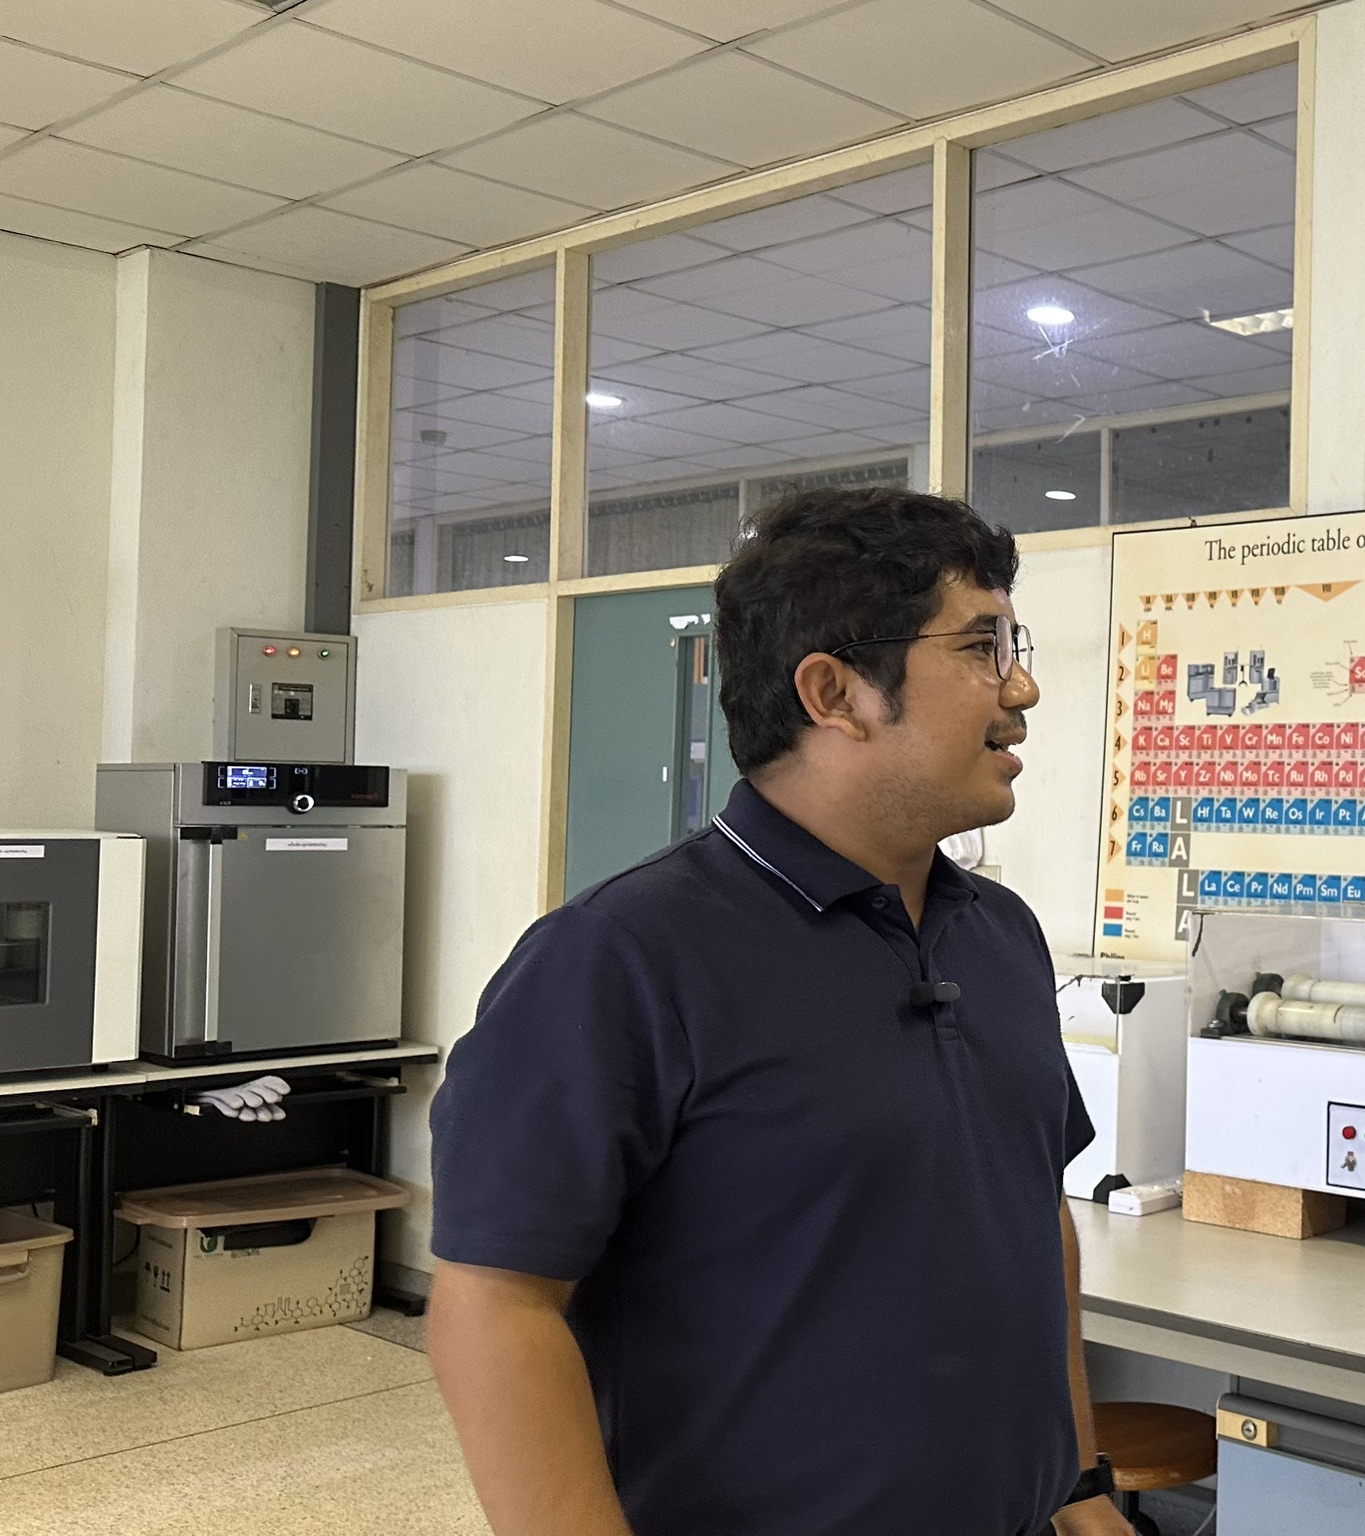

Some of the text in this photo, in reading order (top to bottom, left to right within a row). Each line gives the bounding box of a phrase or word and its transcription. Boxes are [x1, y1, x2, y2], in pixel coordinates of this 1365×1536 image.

[1204, 538, 1236, 561] The
[1241, 532, 1306, 566] periodic
[1311, 527, 1351, 553] table
[1118, 665, 1125, 682] 2
[1160, 663, 1173, 675] Be
[1116, 699, 1174, 717] 3 Na Mg
[1114, 735, 1121, 751] 4
[1156, 734, 1170, 746] Ca
[1179, 734, 1190, 746] Sc
[1201, 733, 1212, 745] Ti
[1244, 733, 1259, 745] Cr
[1266, 733, 1283, 745] Mn
[1292, 732, 1305, 745] Fe
[1314, 732, 1330, 745] Co
[1340, 732, 1353, 744] Ni
[1113, 769, 1120, 787] 5
[1134, 770, 1147, 782] Rb
[1156, 769, 1168, 782] Sr
[1198, 769, 1211, 782] Zr
[1219, 770, 1235, 782] Nb
[1242, 770, 1258, 782] Mo
[1266, 770, 1280, 782] Tc
[1290, 770, 1304, 782] Ru
[1314, 770, 1328, 782] Rh
[1338, 770, 1353, 783] Pd
[1111, 805, 1118, 822] 6
[1132, 805, 1145, 817] Cs
[1153, 805, 1166, 817] Ba
[1175, 801, 1188, 824] L
[1197, 806, 1210, 818] Hf
[1220, 806, 1232, 818] Ta
[1242, 807, 1255, 818] W
[1265, 807, 1279, 820] Re
[1288, 807, 1303, 820] Os
[1338, 808, 1351, 821] Pt
[1109, 837, 1187, 860] 7 Fr Ra A
[1182, 873, 1195, 897] L
[1204, 879, 1217, 891] La
[1226, 880, 1241, 893] Ce
[1251, 881, 1263, 893] Pr
[1273, 882, 1288, 895] Nd
[1295, 883, 1314, 896] Pm
[1320, 884, 1338, 897] Sm
[1347, 885, 1361, 898] Eu
